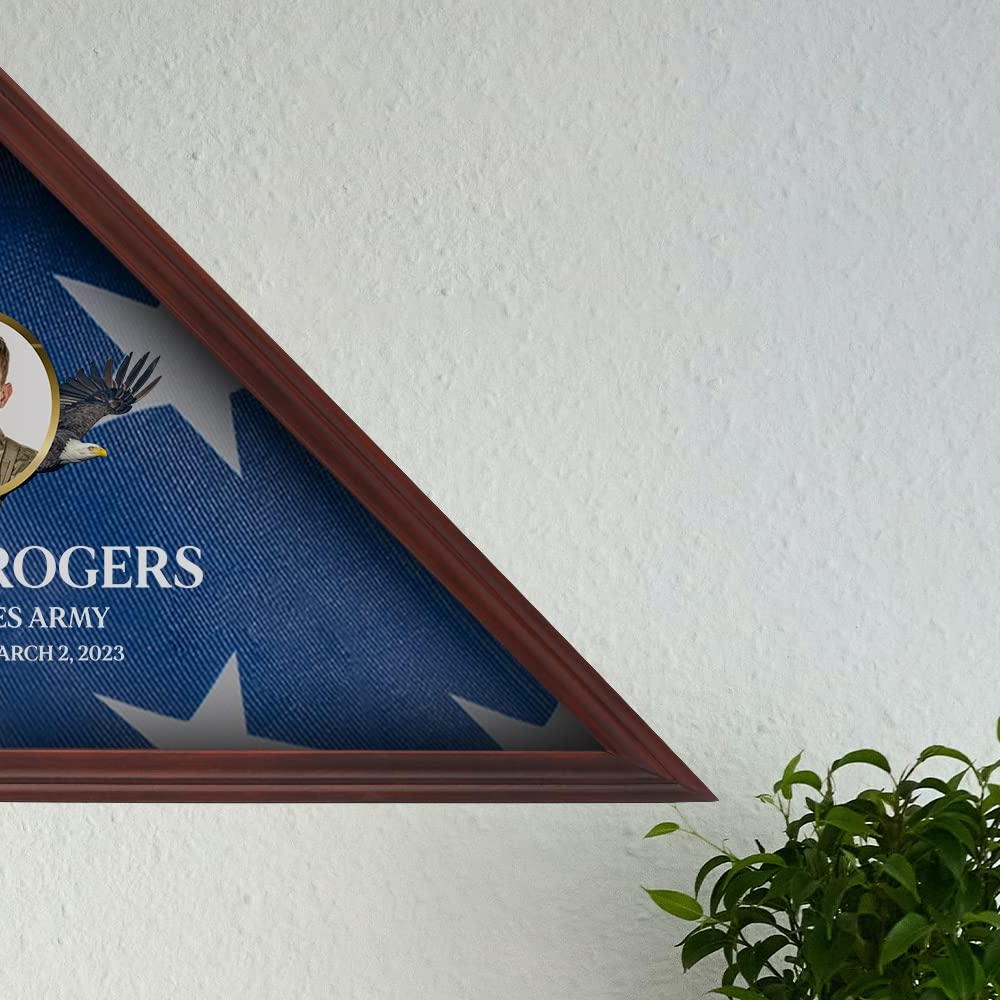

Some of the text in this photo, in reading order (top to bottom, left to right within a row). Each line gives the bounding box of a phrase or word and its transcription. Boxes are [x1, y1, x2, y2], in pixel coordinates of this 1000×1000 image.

[28, 606, 110, 629] ARMY
[58, 645, 74, 664] 2,
[78, 645, 125, 662] 2023
